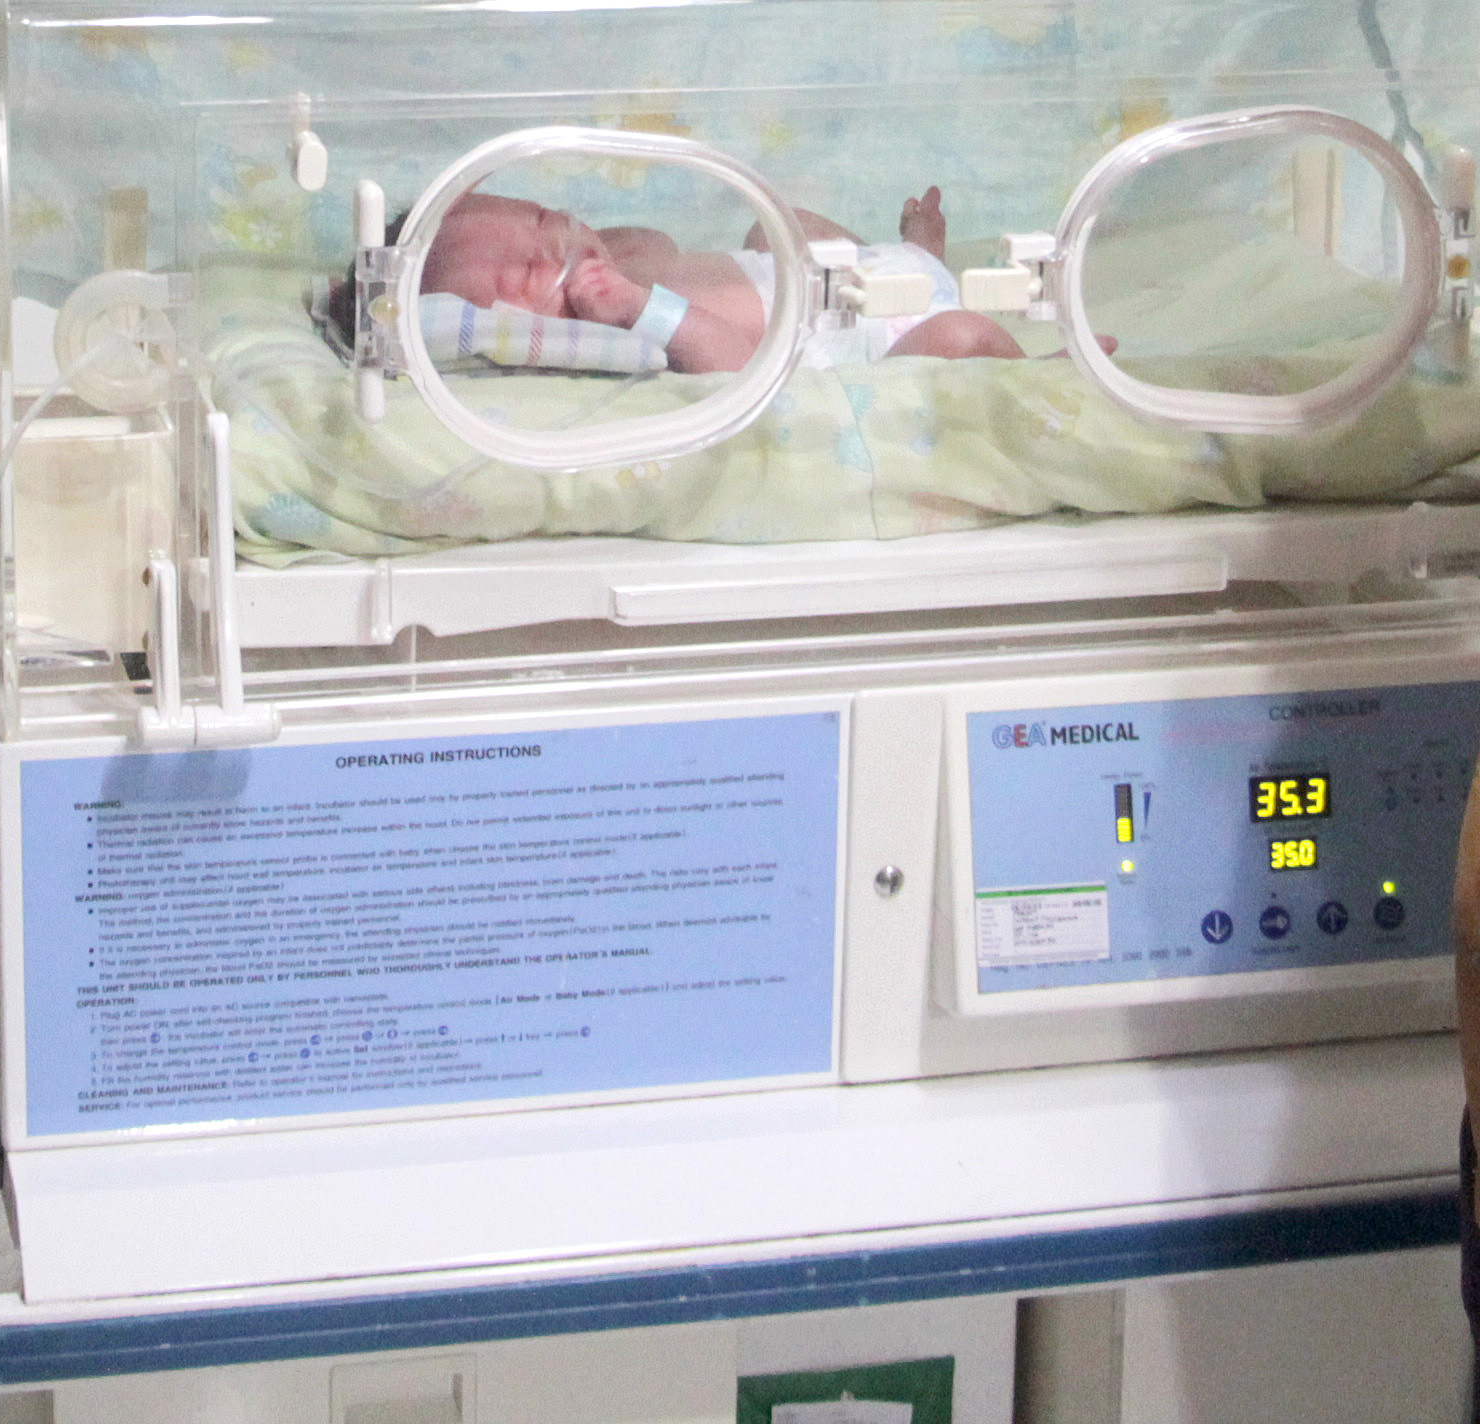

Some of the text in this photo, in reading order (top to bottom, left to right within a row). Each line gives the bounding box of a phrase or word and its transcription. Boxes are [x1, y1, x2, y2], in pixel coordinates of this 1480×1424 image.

[1269, 698, 1381, 722] CONTROLLER
[992, 721, 1140, 750] GEA MEDICAL
[335, 744, 541, 769] OPERATING INSTRUCTIONS
[1256, 777, 1327, 818] 35.3
[77, 986, 99, 995] THIS
[102, 984, 124, 994] UNIT
[128, 981, 169, 992] SHOULD
[189, 976, 243, 987] OPERATED
[246, 974, 273, 983] ONLY
[293, 968, 351, 980] PERSONNEL
